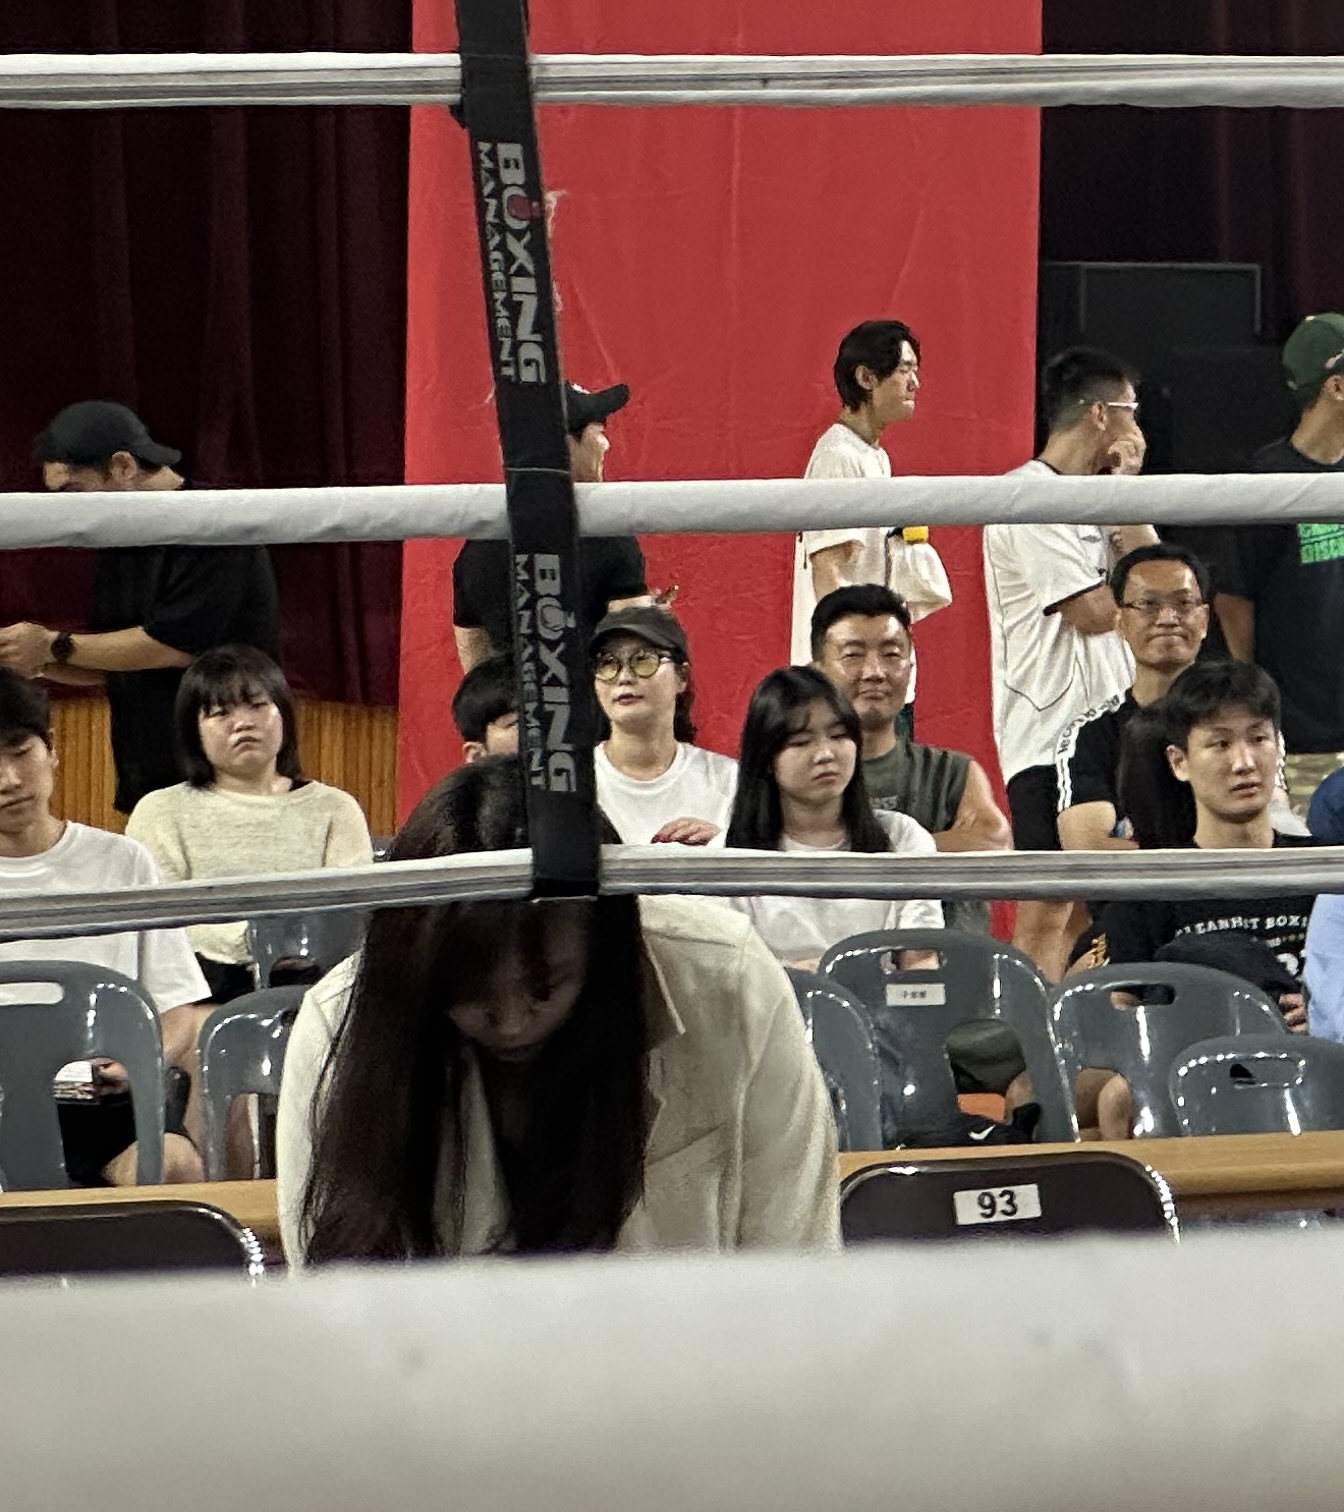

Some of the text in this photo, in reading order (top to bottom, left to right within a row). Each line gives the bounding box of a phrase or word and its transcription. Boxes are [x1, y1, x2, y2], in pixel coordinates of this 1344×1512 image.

[477, 140, 515, 381] MANAGEMENT
[497, 142, 546, 385] BOXING
[514, 552, 547, 790] MANAGEMENT
[534, 553, 577, 793] BOXING
[976, 1189, 1019, 1219] 93
